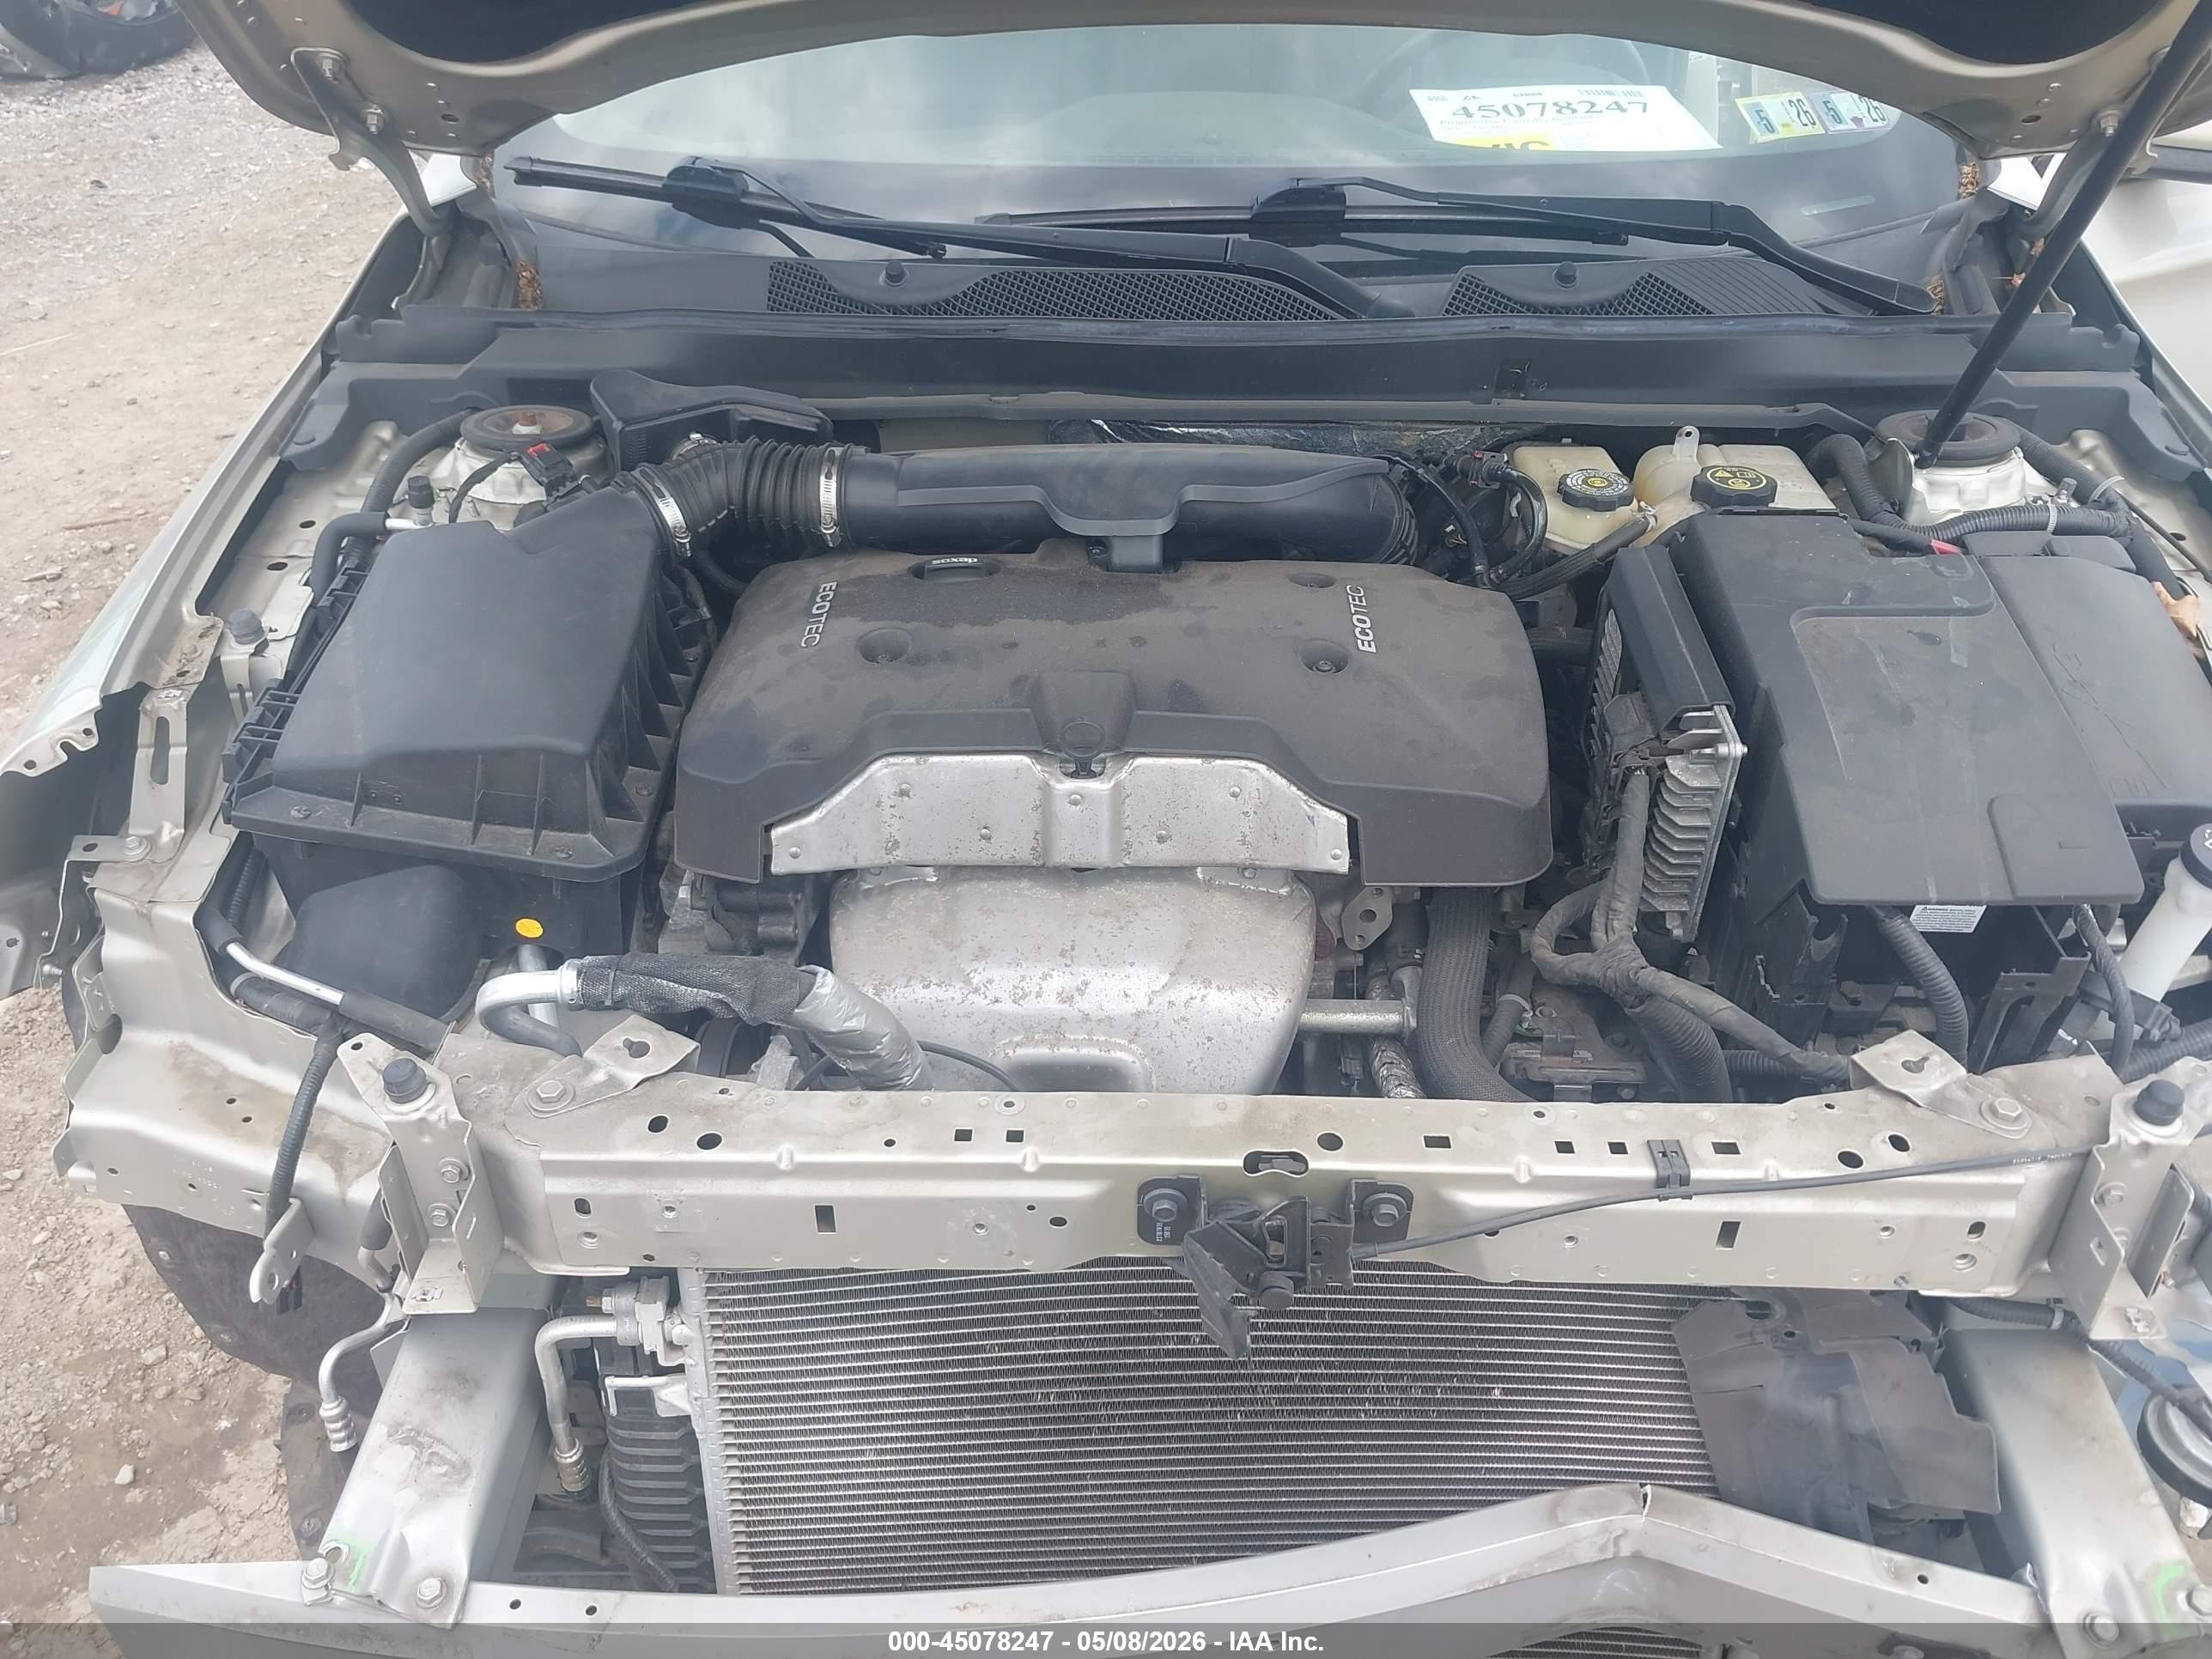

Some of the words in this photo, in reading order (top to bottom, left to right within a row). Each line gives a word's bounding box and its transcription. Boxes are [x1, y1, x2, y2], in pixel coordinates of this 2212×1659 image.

[1452, 100, 1648, 118] 45078247
[1754, 109, 1775, 134] 5
[1788, 98, 1817, 127] 26
[1822, 100, 1843, 124] 5
[1858, 95, 1887, 123] 26
[800, 581, 838, 648] ECOTEC
[1346, 585, 1376, 653] ECOTEC
